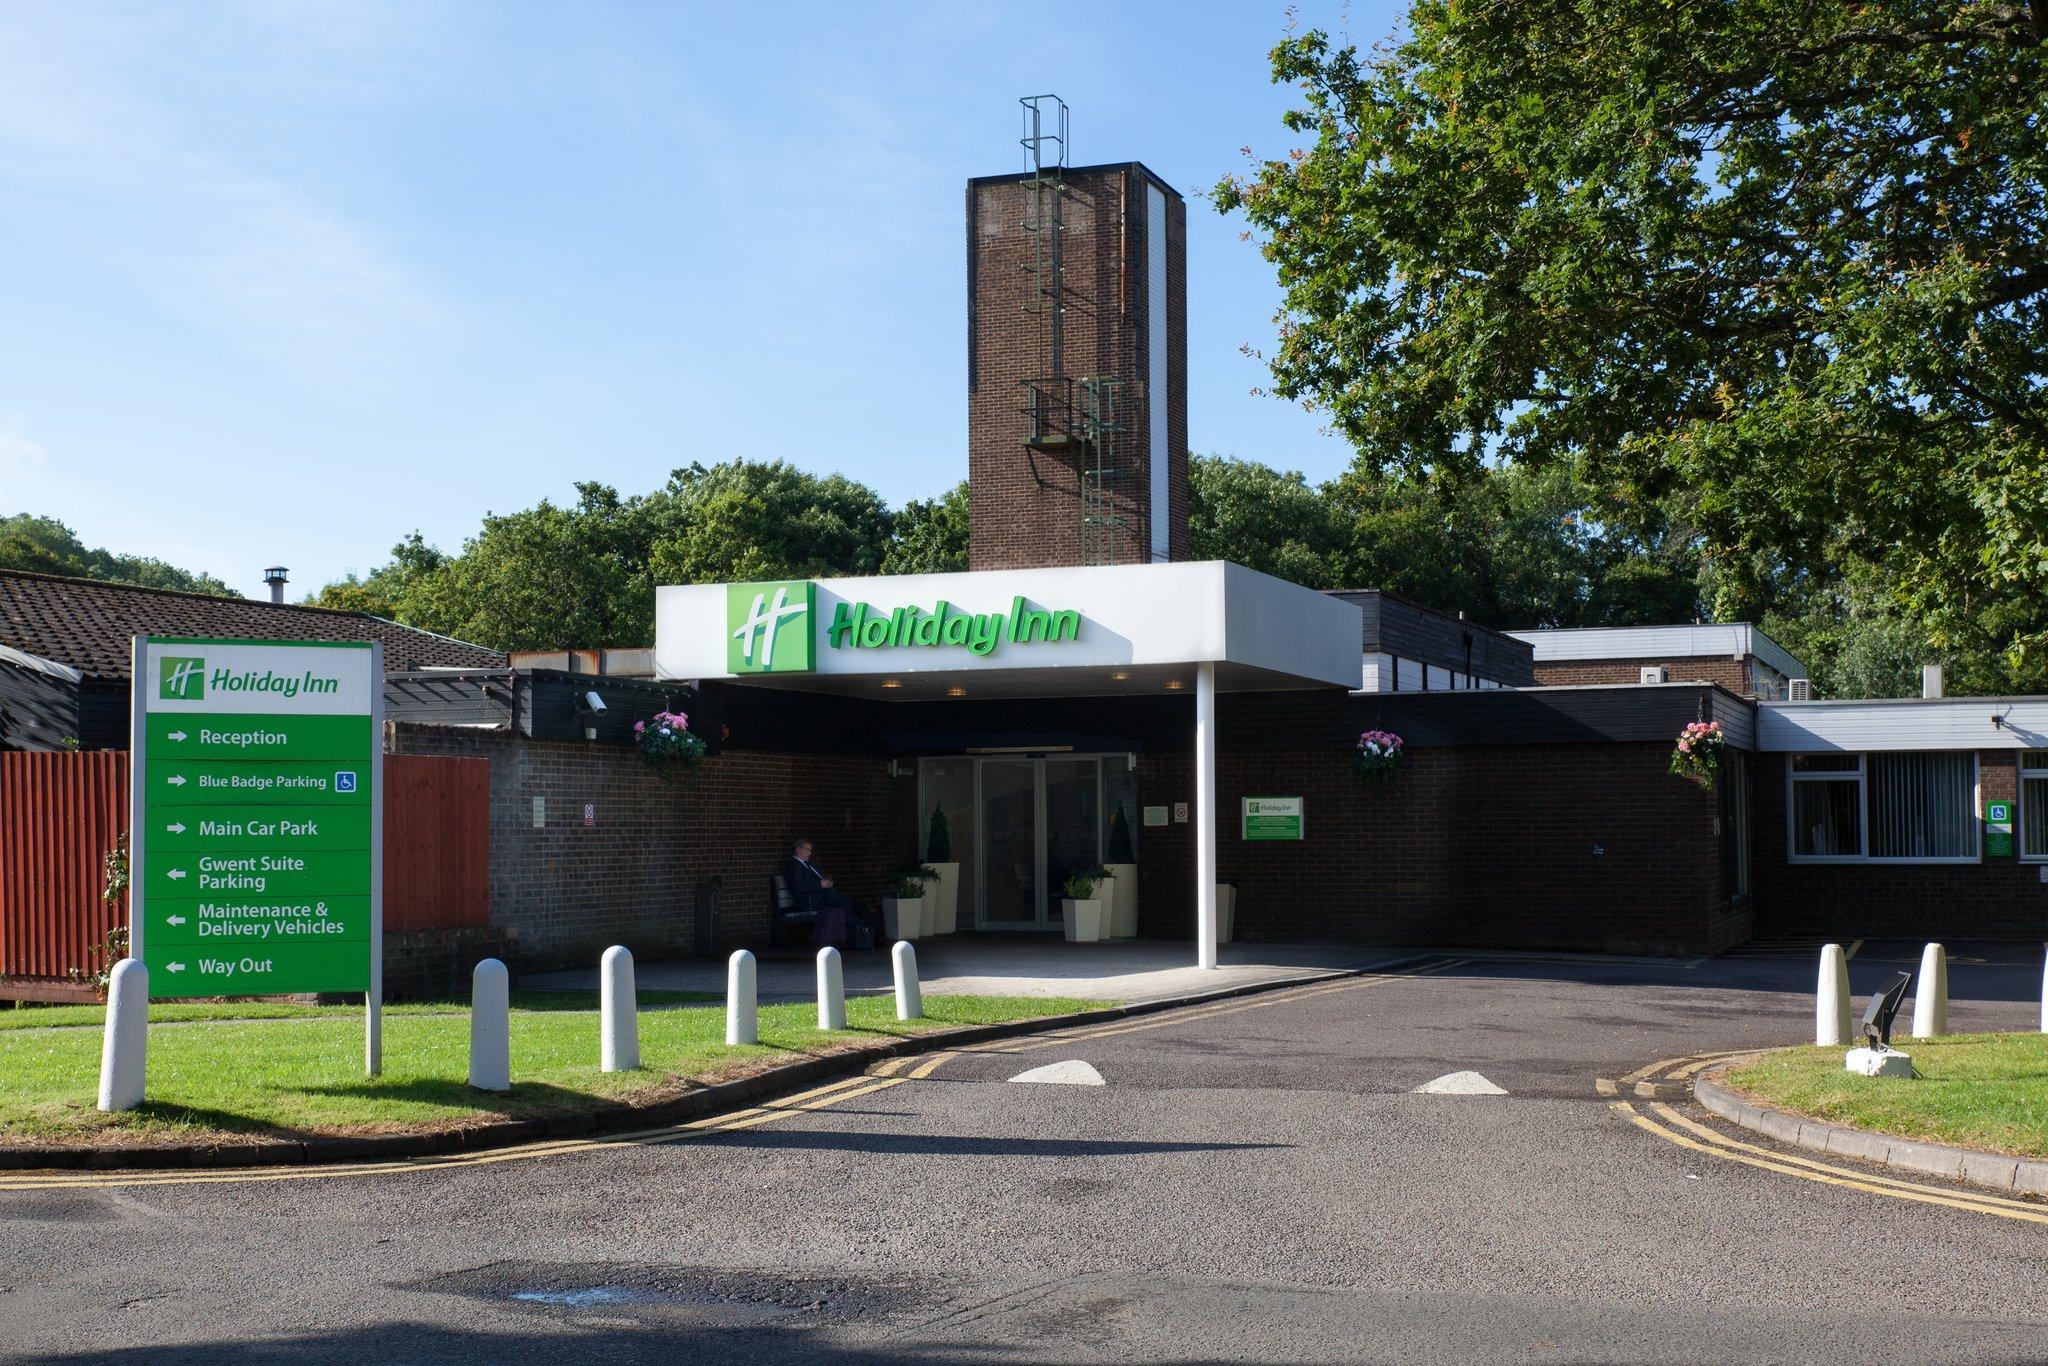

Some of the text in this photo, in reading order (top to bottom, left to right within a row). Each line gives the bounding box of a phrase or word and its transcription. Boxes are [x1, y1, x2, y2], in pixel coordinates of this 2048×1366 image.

[827, 595, 1081, 656] Holiday Inn
[210, 668, 339, 698] Holiday Inn
[200, 729, 287, 748] Reception
[199, 775, 327, 790] Blue Badge Parking
[199, 820, 318, 836] Main Car Park
[199, 856, 304, 871] Gwent Suite
[199, 874, 266, 892] Parking
[199, 902, 328, 919] Maintenance &
[199, 919, 344, 939] Delivery Vehicles
[199, 958, 273, 977] Way Out
